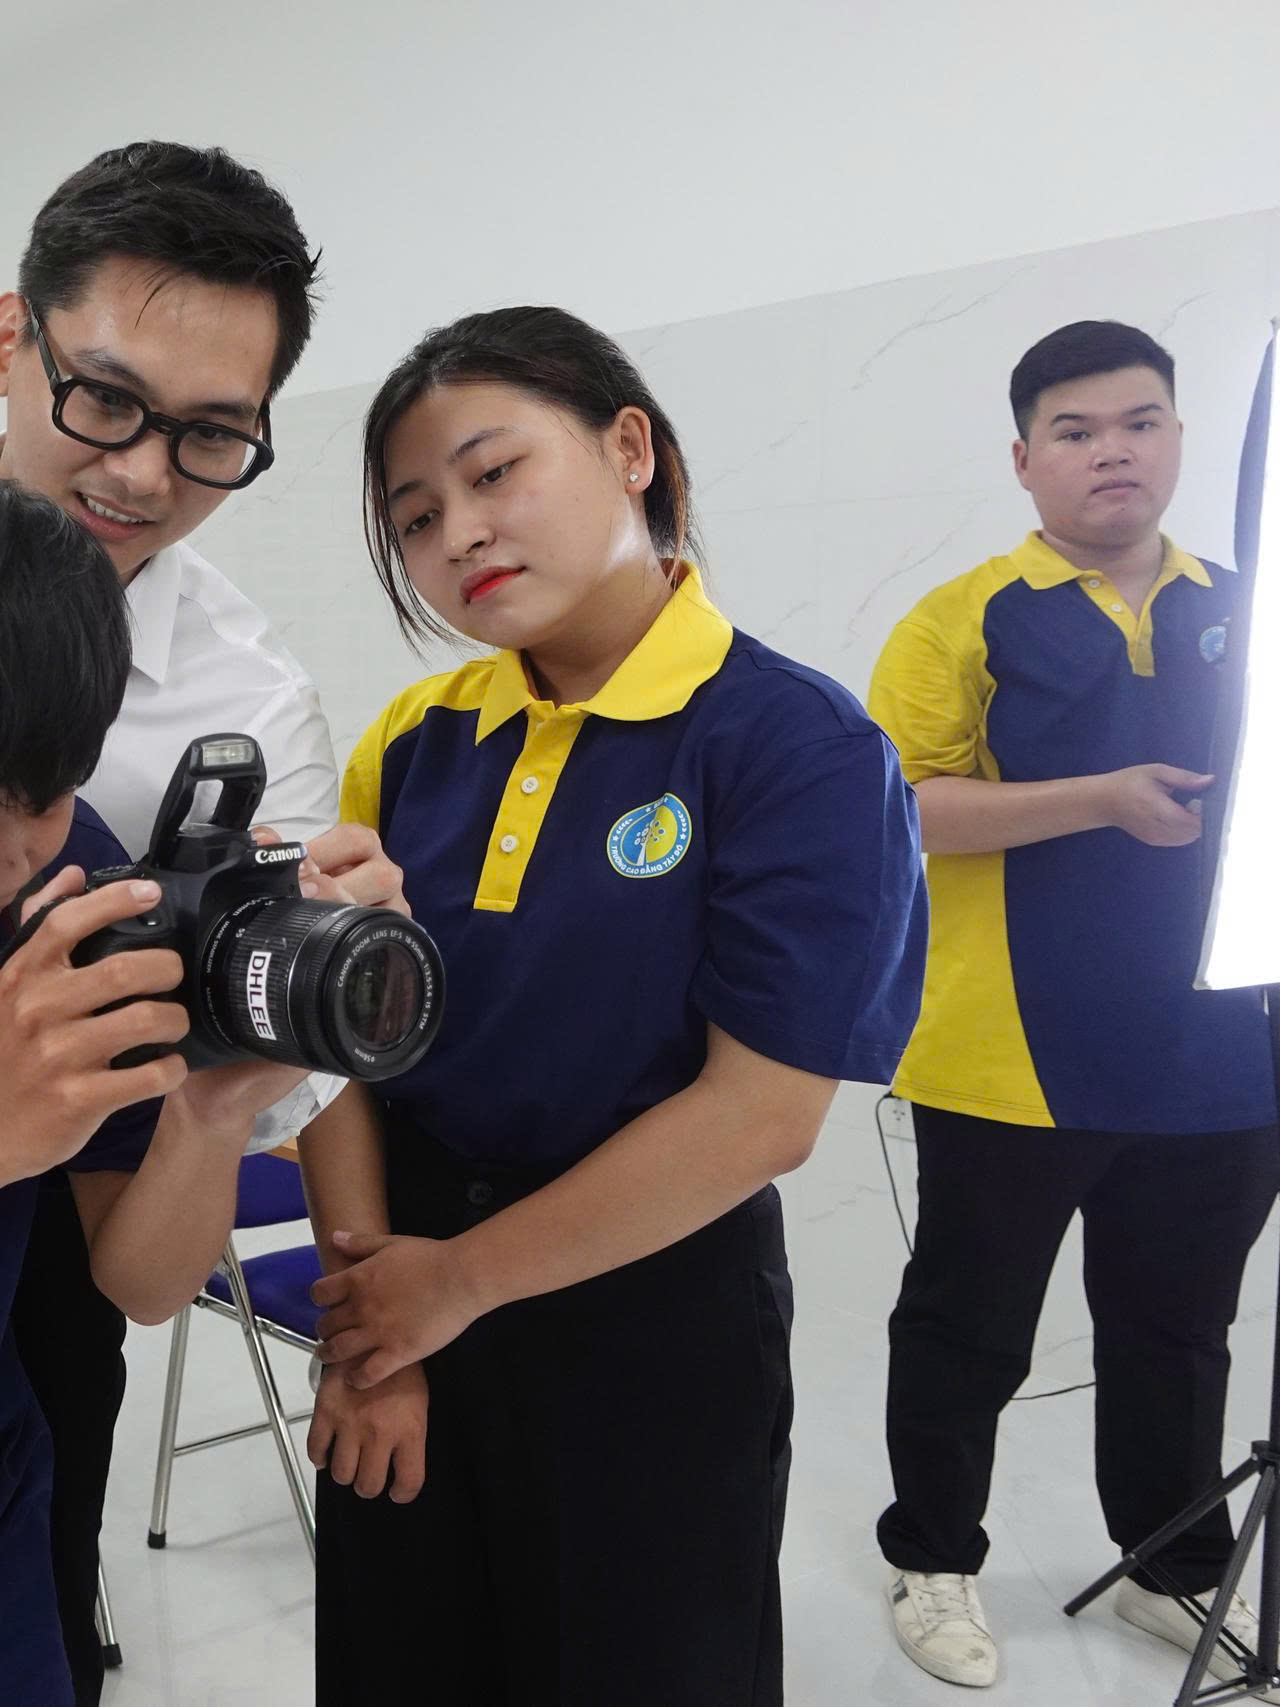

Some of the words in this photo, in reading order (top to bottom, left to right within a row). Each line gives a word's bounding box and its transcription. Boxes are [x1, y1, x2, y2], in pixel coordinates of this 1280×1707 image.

[255, 848, 301, 864] Canon
[337, 957, 352, 988] CANON
[352, 936, 371, 956] ZOOM
[372, 929, 388, 940] LENS
[249, 956, 272, 1036] DHLEE
